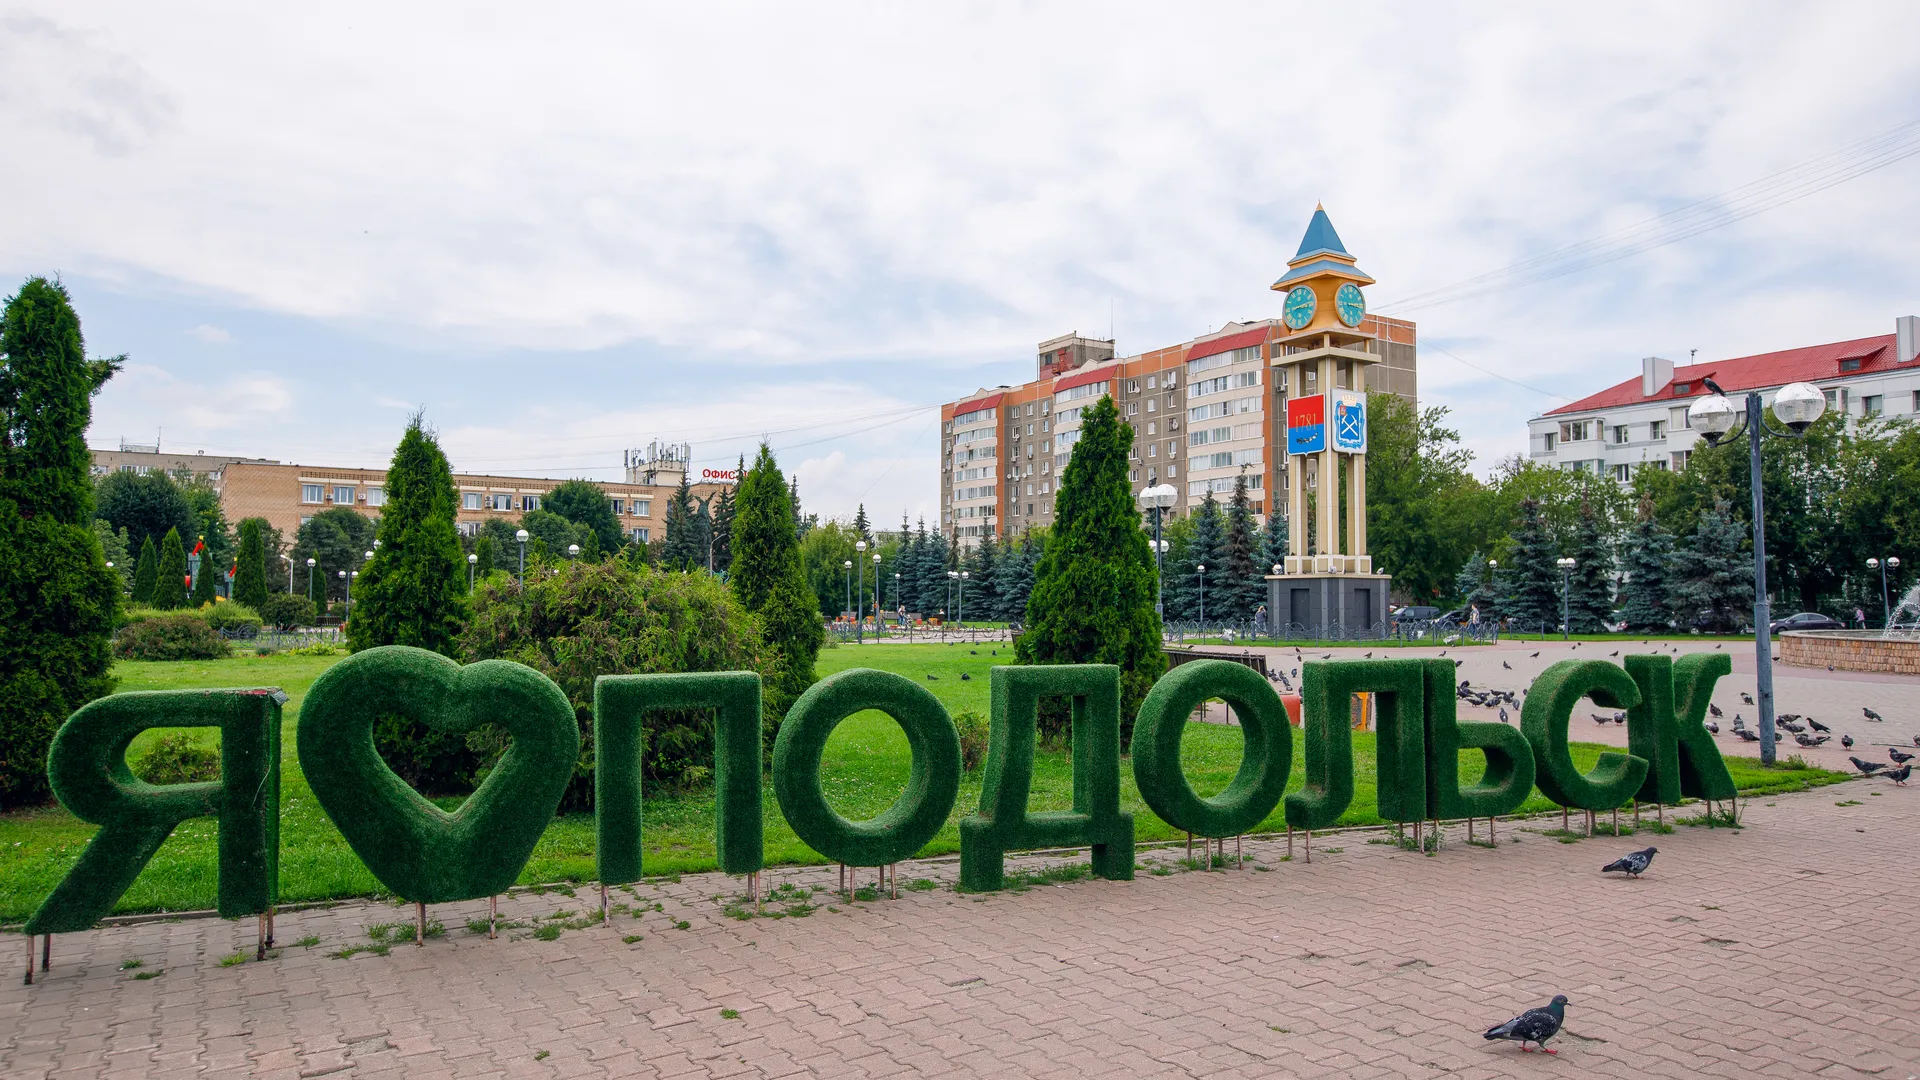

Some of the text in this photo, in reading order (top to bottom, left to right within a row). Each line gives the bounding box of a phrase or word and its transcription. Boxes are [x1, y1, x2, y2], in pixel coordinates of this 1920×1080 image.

[1295, 412, 1317, 432] 1781
[24, 652, 1738, 934] Я ПОДОЛЬСК
